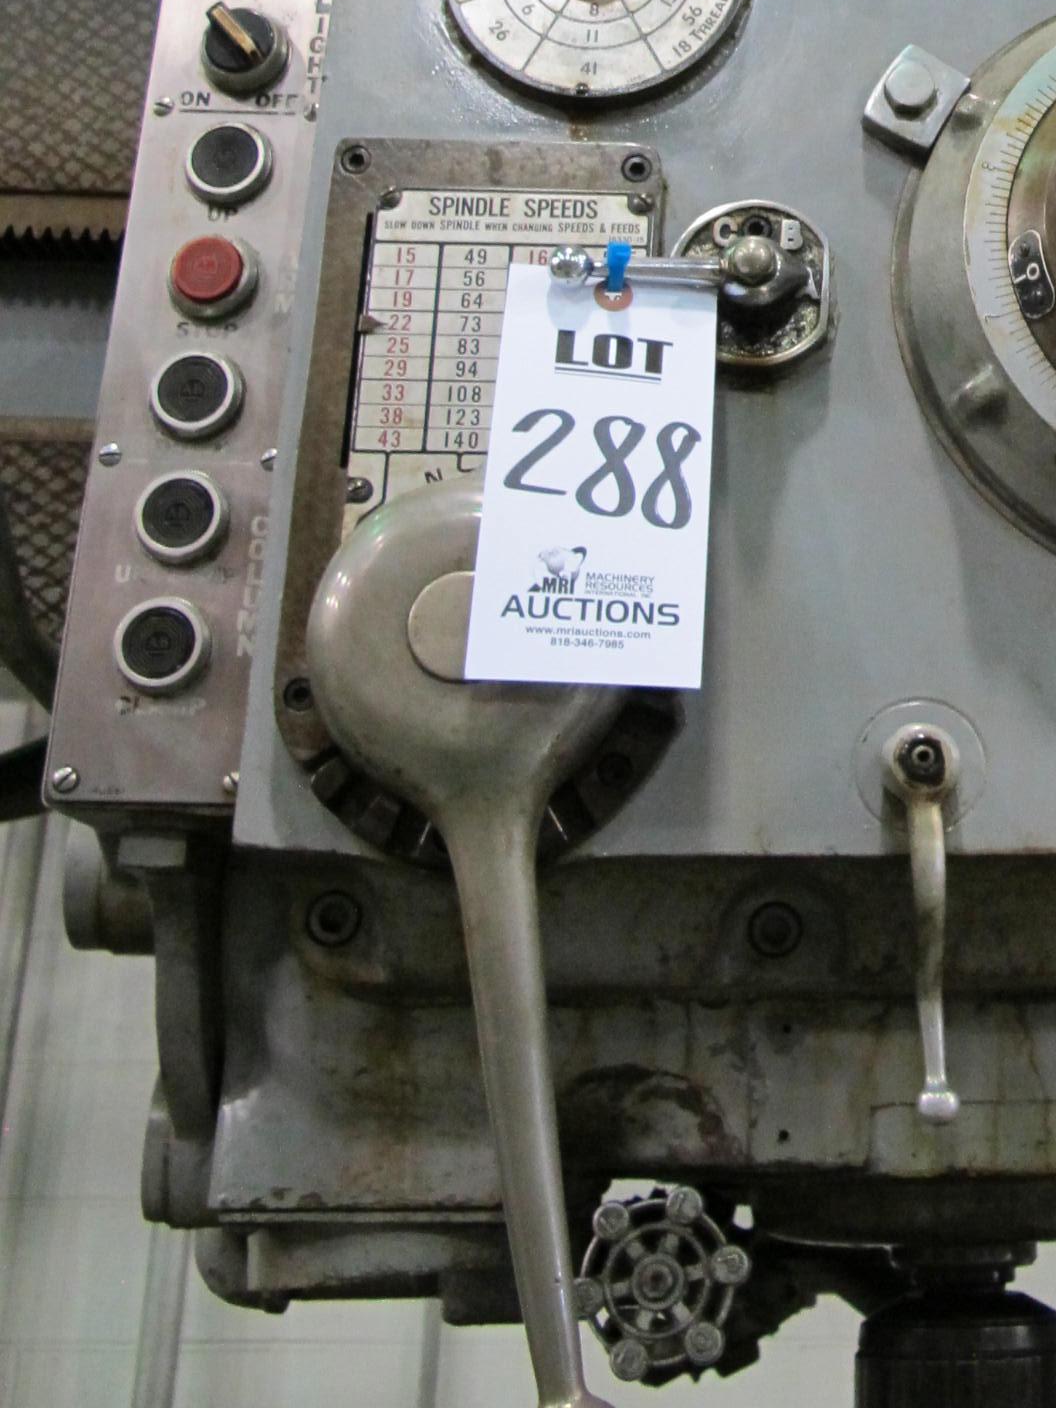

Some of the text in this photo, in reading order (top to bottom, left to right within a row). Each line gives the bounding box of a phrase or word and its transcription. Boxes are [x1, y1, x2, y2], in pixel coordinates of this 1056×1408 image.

[522, 4, 535, 16] 6
[589, 2, 600, 17] 8
[681, 5, 703, 27] 56
[489, 20, 510, 42] 26
[586, 29, 599, 43] 11
[672, 40, 692, 58] 18
[580, 61, 598, 76] 41
[180, 92, 210, 106] ON
[429, 196, 598, 219] SPINDLE SPEEDS
[384, 221, 406, 230] SLOW
[411, 221, 435, 230] DOWN
[440, 221, 480, 231] SPINDLE
[485, 223, 508, 232] WHEN
[558, 223, 595, 233] SPEEDS
[600, 224, 606, 233] &
[610, 223, 641, 234] FEEDS
[396, 248, 548, 265] 15 49 16
[394, 271, 485, 287] 17 56
[393, 292, 484, 310] 19 64
[389, 315, 482, 332] 22 73
[387, 337, 480, 355] 25 83
[555, 329, 673, 375] LOT
[385, 360, 478, 378] 29 94
[382, 384, 481, 402] 33 108
[379, 407, 480, 426] 38 123
[377, 430, 478, 449] 43 140
[504, 409, 702, 529] 288
[542, 577, 576, 595] MRI
[586, 571, 655, 584] MACHINERY
[585, 582, 654, 593] RESOURCES
[501, 595, 679, 626] AUCTIONS
[525, 625, 651, 639] www.mriauctions.com
